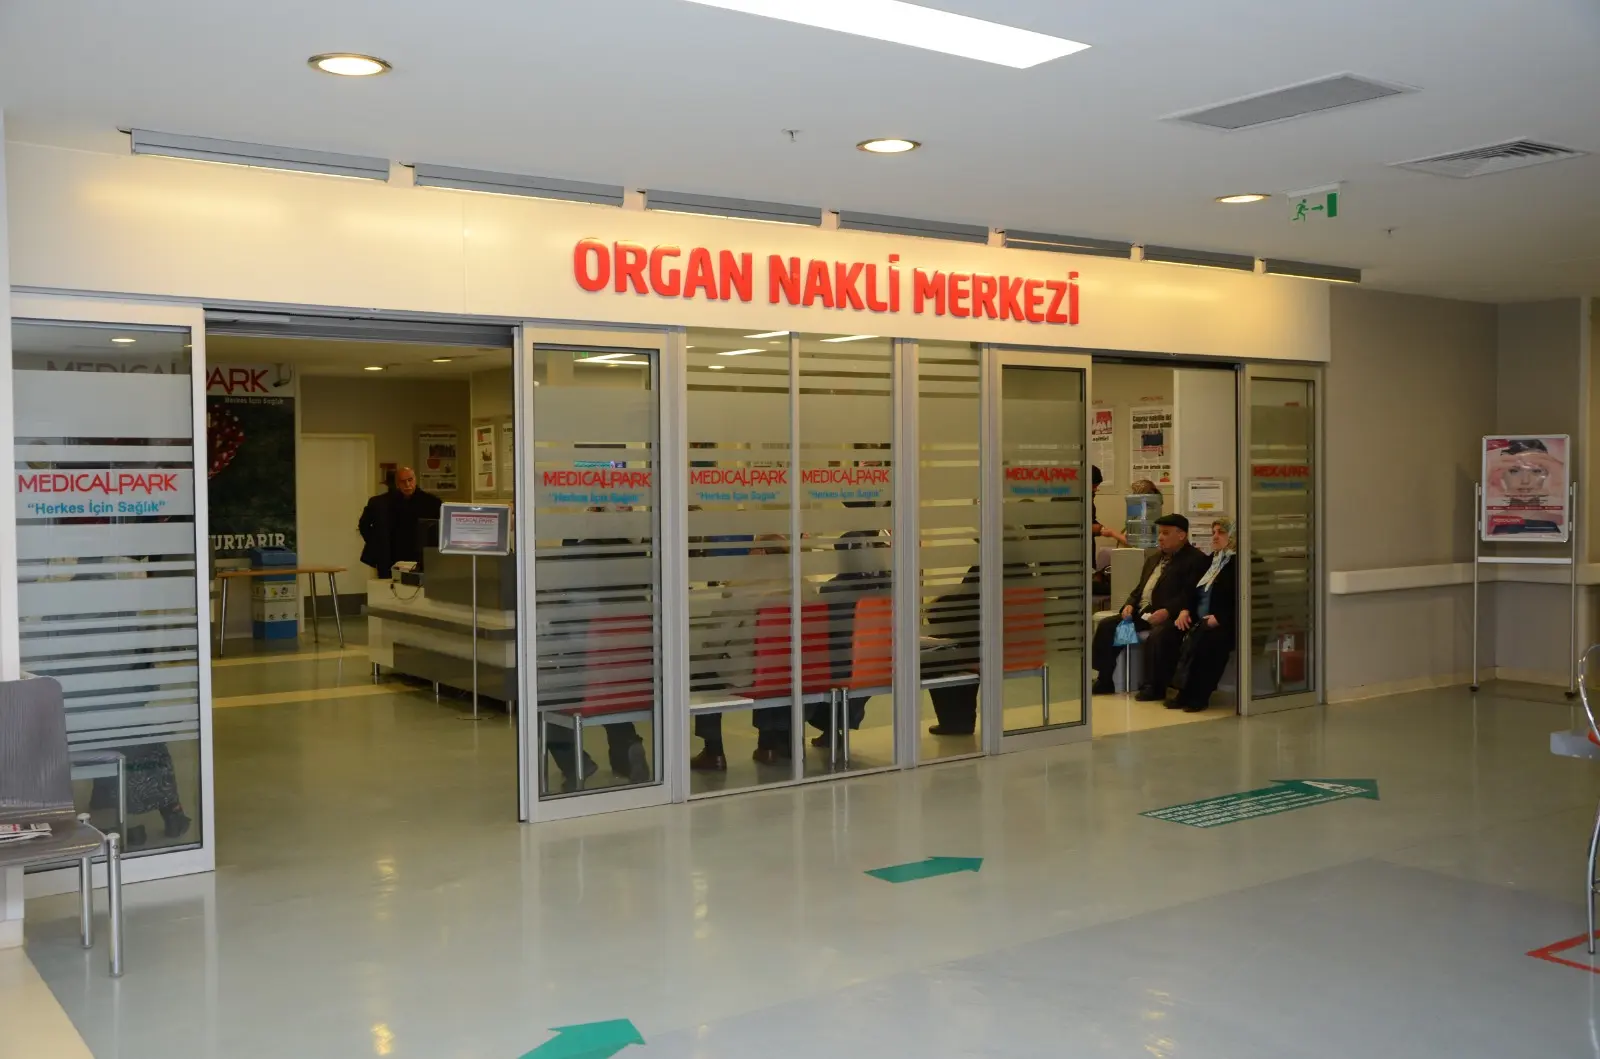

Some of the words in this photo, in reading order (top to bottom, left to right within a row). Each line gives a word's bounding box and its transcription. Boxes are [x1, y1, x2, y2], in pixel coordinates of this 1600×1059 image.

[574, 237, 753, 302] ORGAN
[769, 254, 900, 312] NAKLİ
[913, 267, 1079, 325] MERKEZİ
[18, 471, 178, 495] MEDICALPARK
[543, 469, 651, 489] MEDICALPARK
[690, 468, 787, 487] MEDICALPARK
[802, 467, 889, 486] MEDICALPARK
[89, 499, 113, 515] İçin
